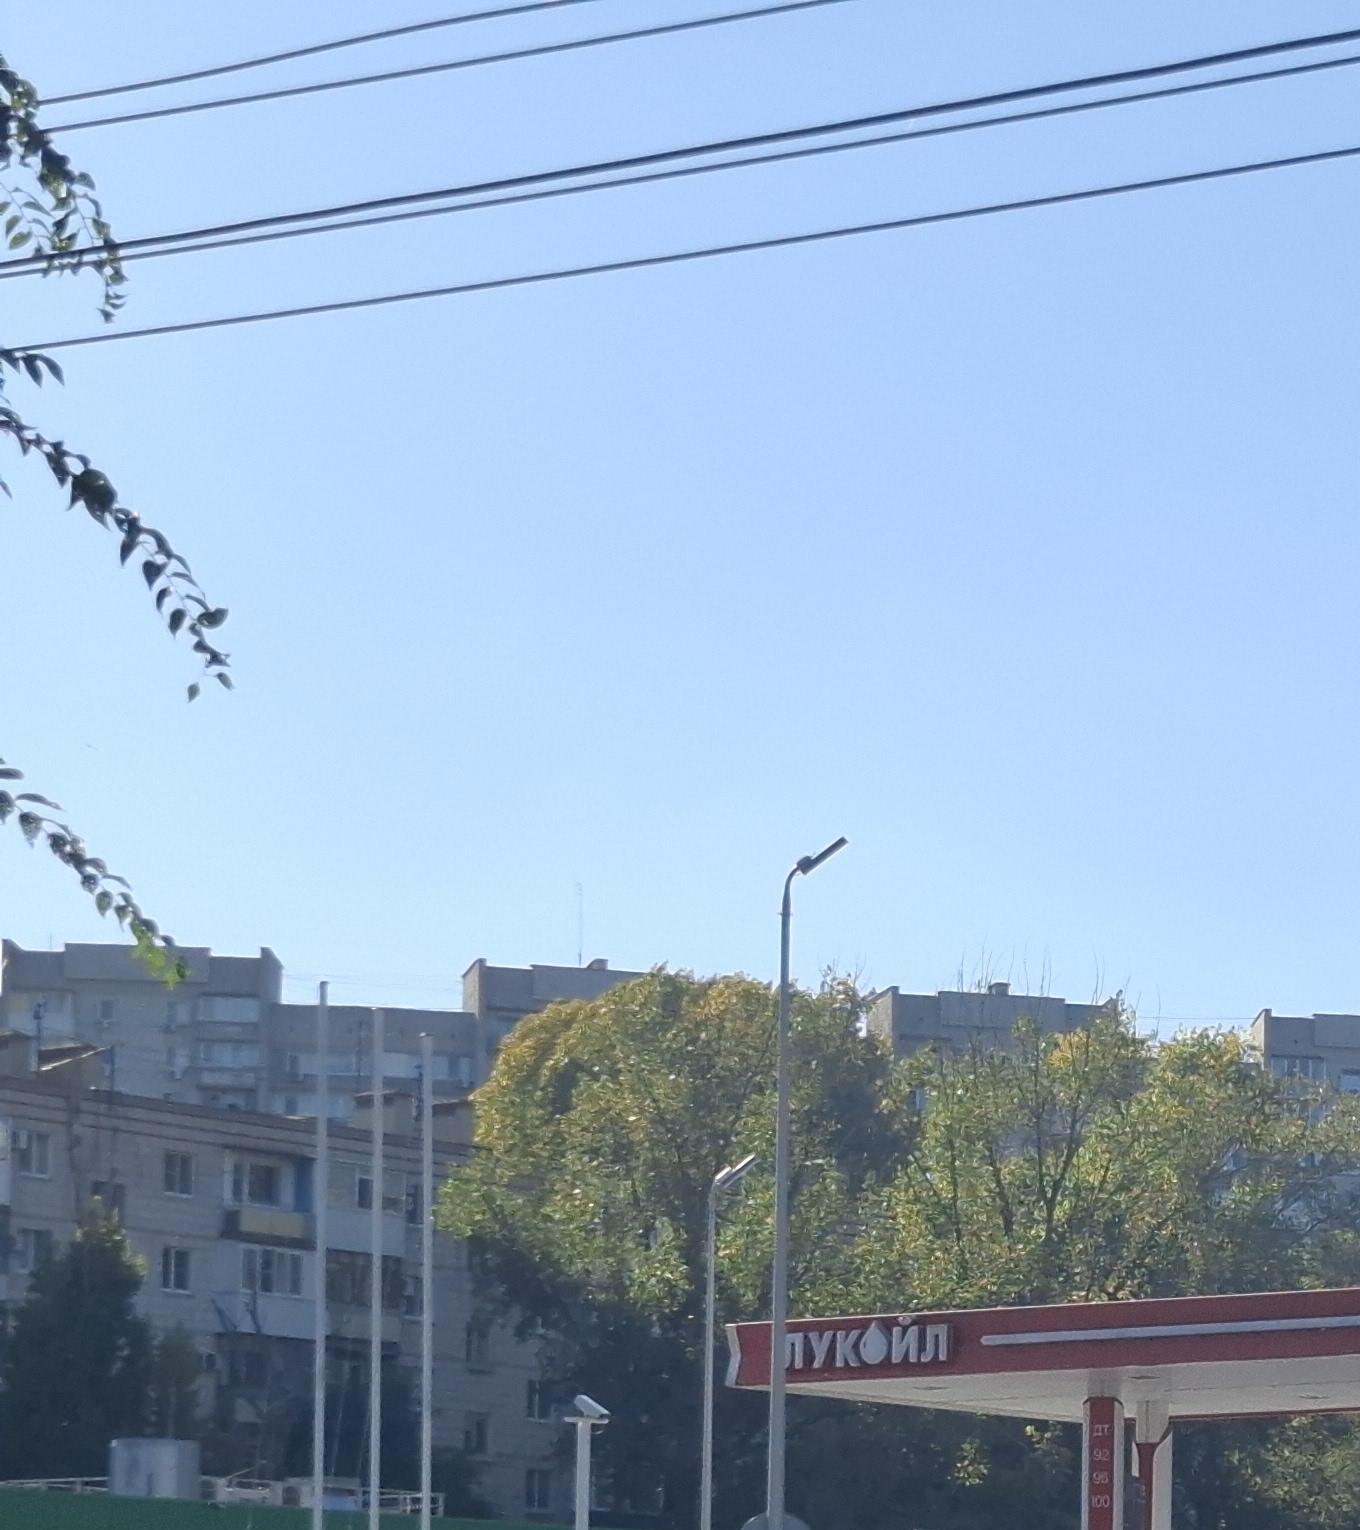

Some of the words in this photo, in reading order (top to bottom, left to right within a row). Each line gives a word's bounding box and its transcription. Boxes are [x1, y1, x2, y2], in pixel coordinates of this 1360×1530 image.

[1092, 1424, 1109, 1437] ДТ
[1093, 1448, 1109, 1461] 92
[1092, 1471, 1109, 1484] 95
